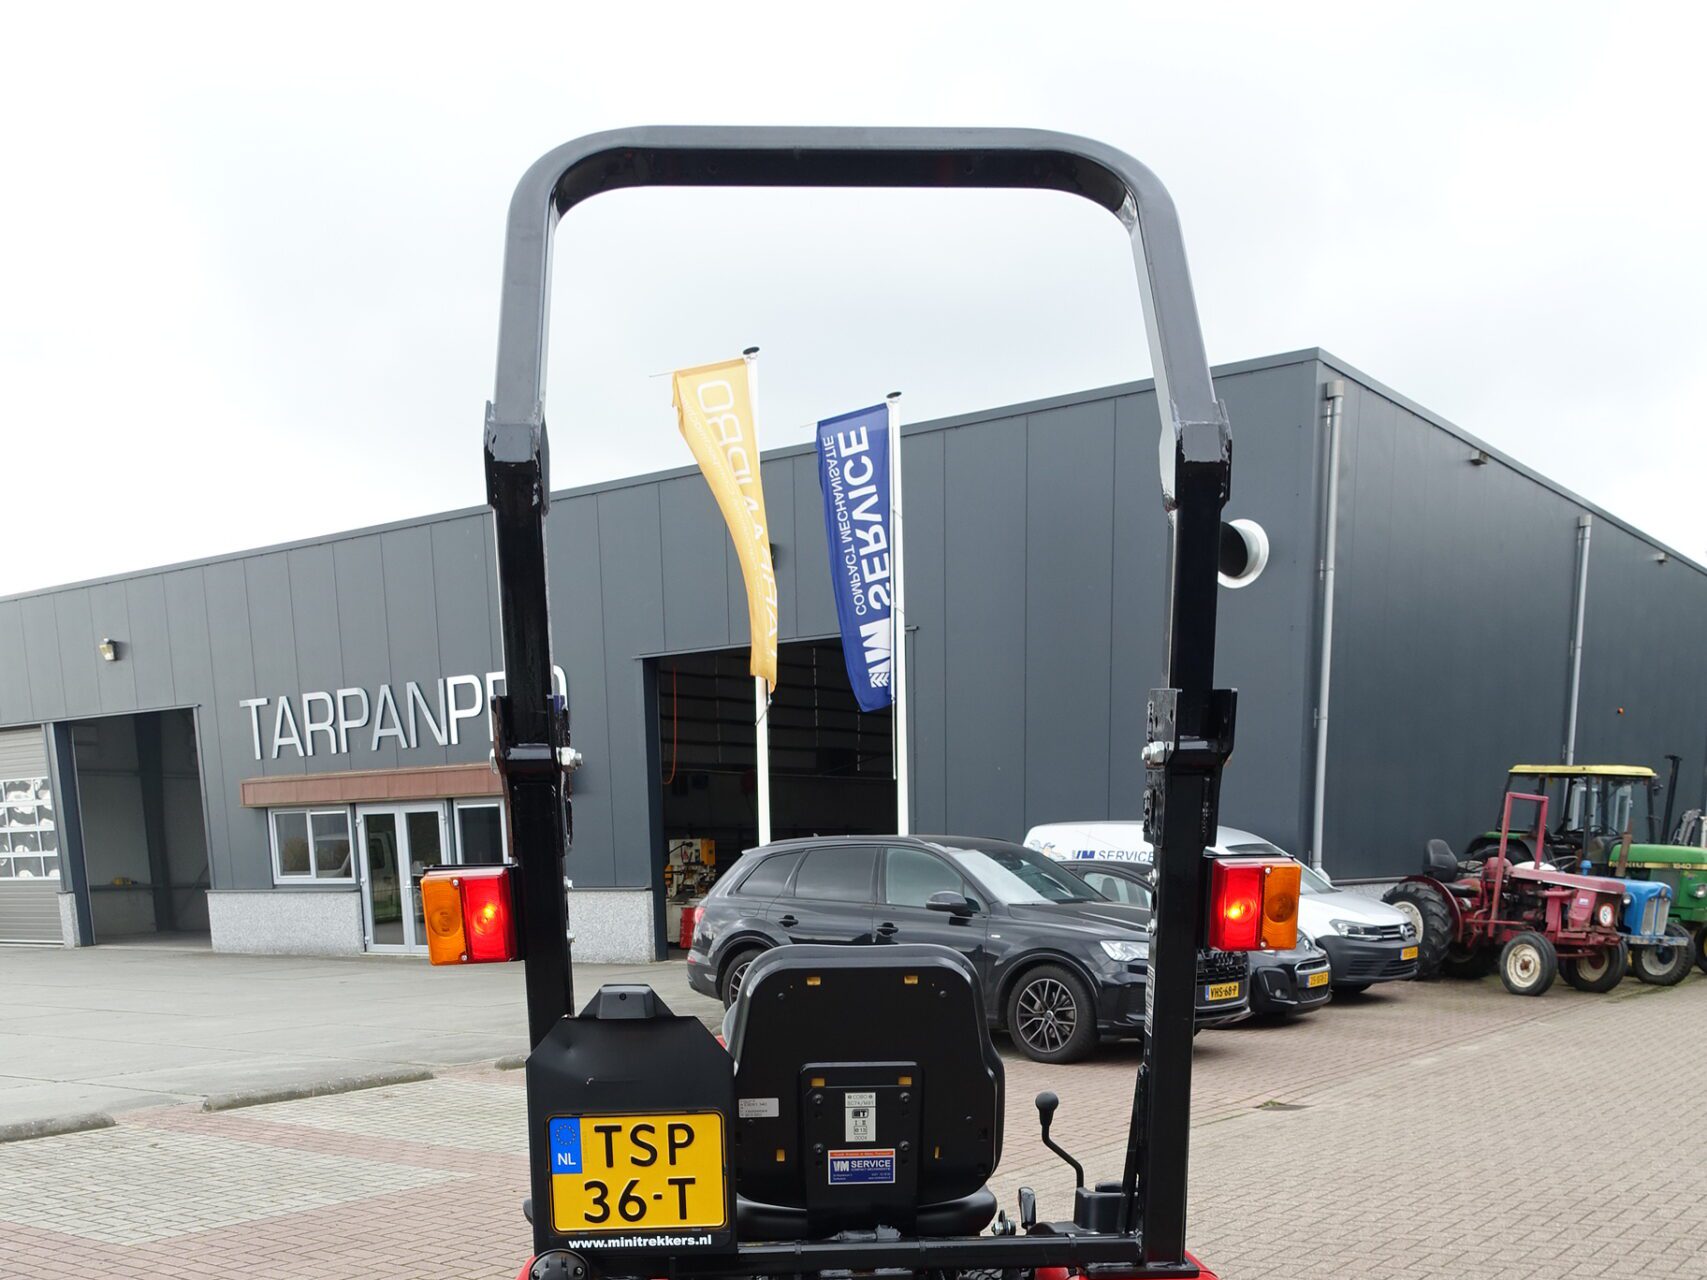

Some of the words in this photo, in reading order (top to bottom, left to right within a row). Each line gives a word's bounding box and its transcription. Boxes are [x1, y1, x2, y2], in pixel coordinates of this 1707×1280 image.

[239, 664, 568, 760] TARPANP
[557, 1152, 576, 1166] NL
[593, 1122, 695, 1169] TSP
[850, 1159, 891, 1169] SERVICE
[583, 1177, 697, 1224] 36-T
[567, 1234, 713, 1250] www.minitrekkers.nl
